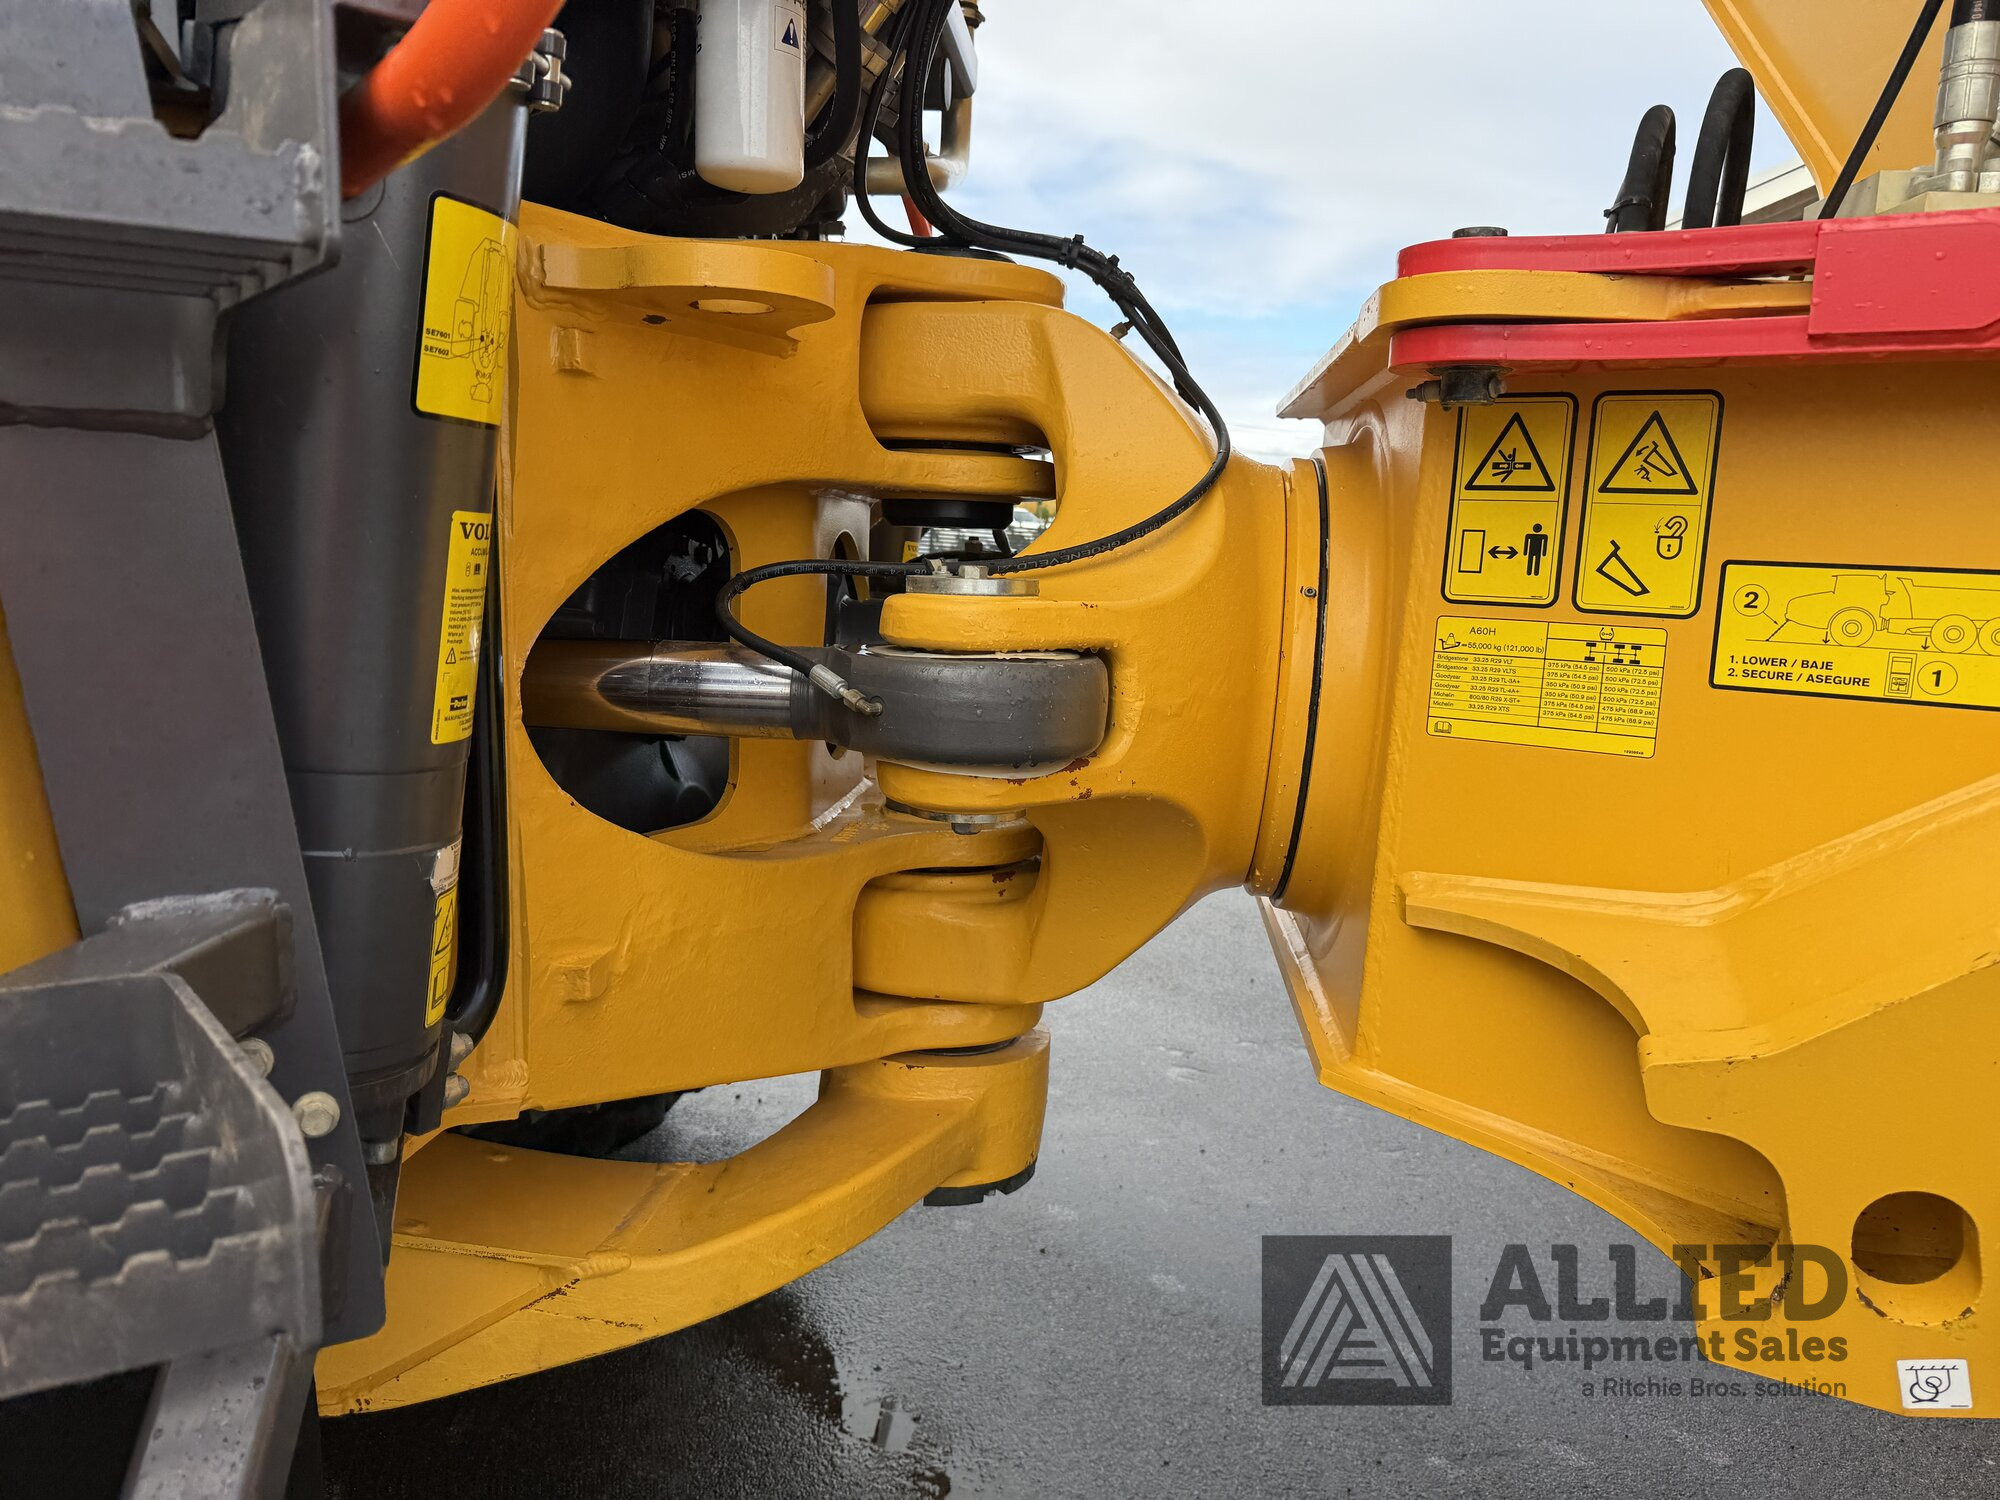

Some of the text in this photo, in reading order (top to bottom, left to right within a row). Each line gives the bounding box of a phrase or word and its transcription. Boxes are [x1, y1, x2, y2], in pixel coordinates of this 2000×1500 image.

[1016, 540, 1120, 570] GROENEVELD
[1744, 592, 1758, 608] 2
[1469, 626, 1496, 636] A60H
[1504, 644, 1534, 653] (121,000
[1536, 646, 1545, 654] lb)
[1730, 655, 1834, 670] 1. LOWER / BAJE
[1728, 668, 1870, 687] 2. SECURE / ASEGURE
[1932, 670, 1942, 687] 1
